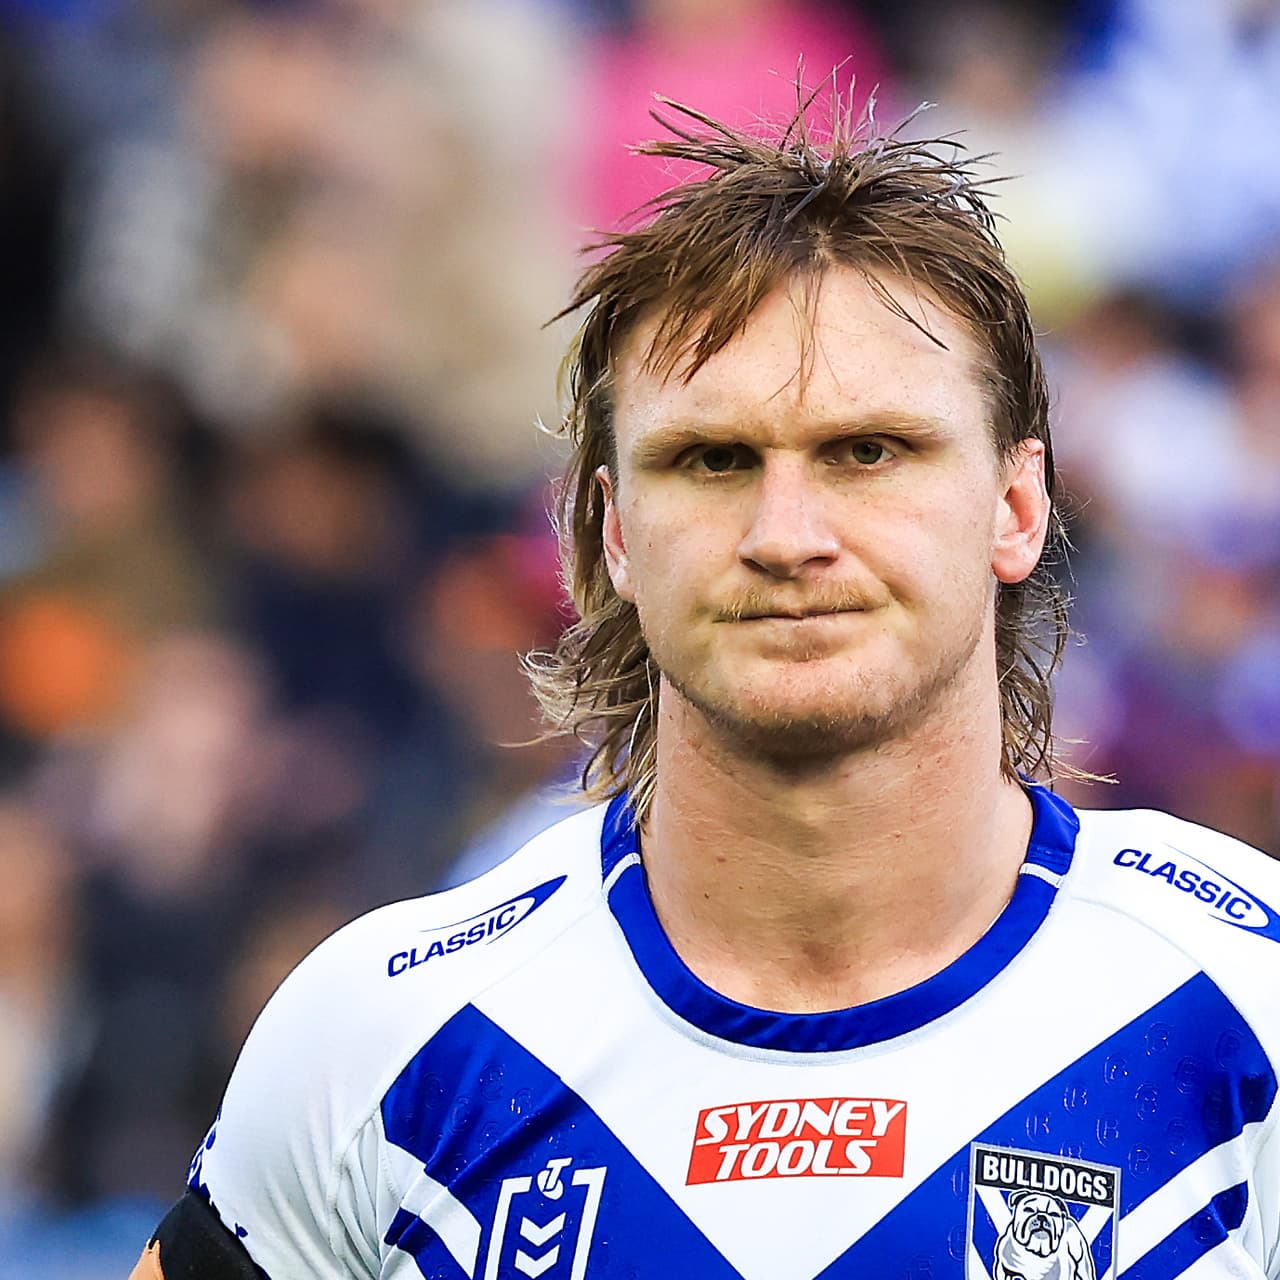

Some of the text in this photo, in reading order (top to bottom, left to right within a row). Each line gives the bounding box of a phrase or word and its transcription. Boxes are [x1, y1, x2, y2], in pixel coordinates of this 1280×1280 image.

[1112, 848, 1252, 920] CLASSIC
[387, 904, 517, 978] CLASSIC
[695, 1099, 906, 1146] SYDNEY
[715, 1139, 878, 1181] TOOLS
[982, 1154, 1108, 1201] BULLDOGS
